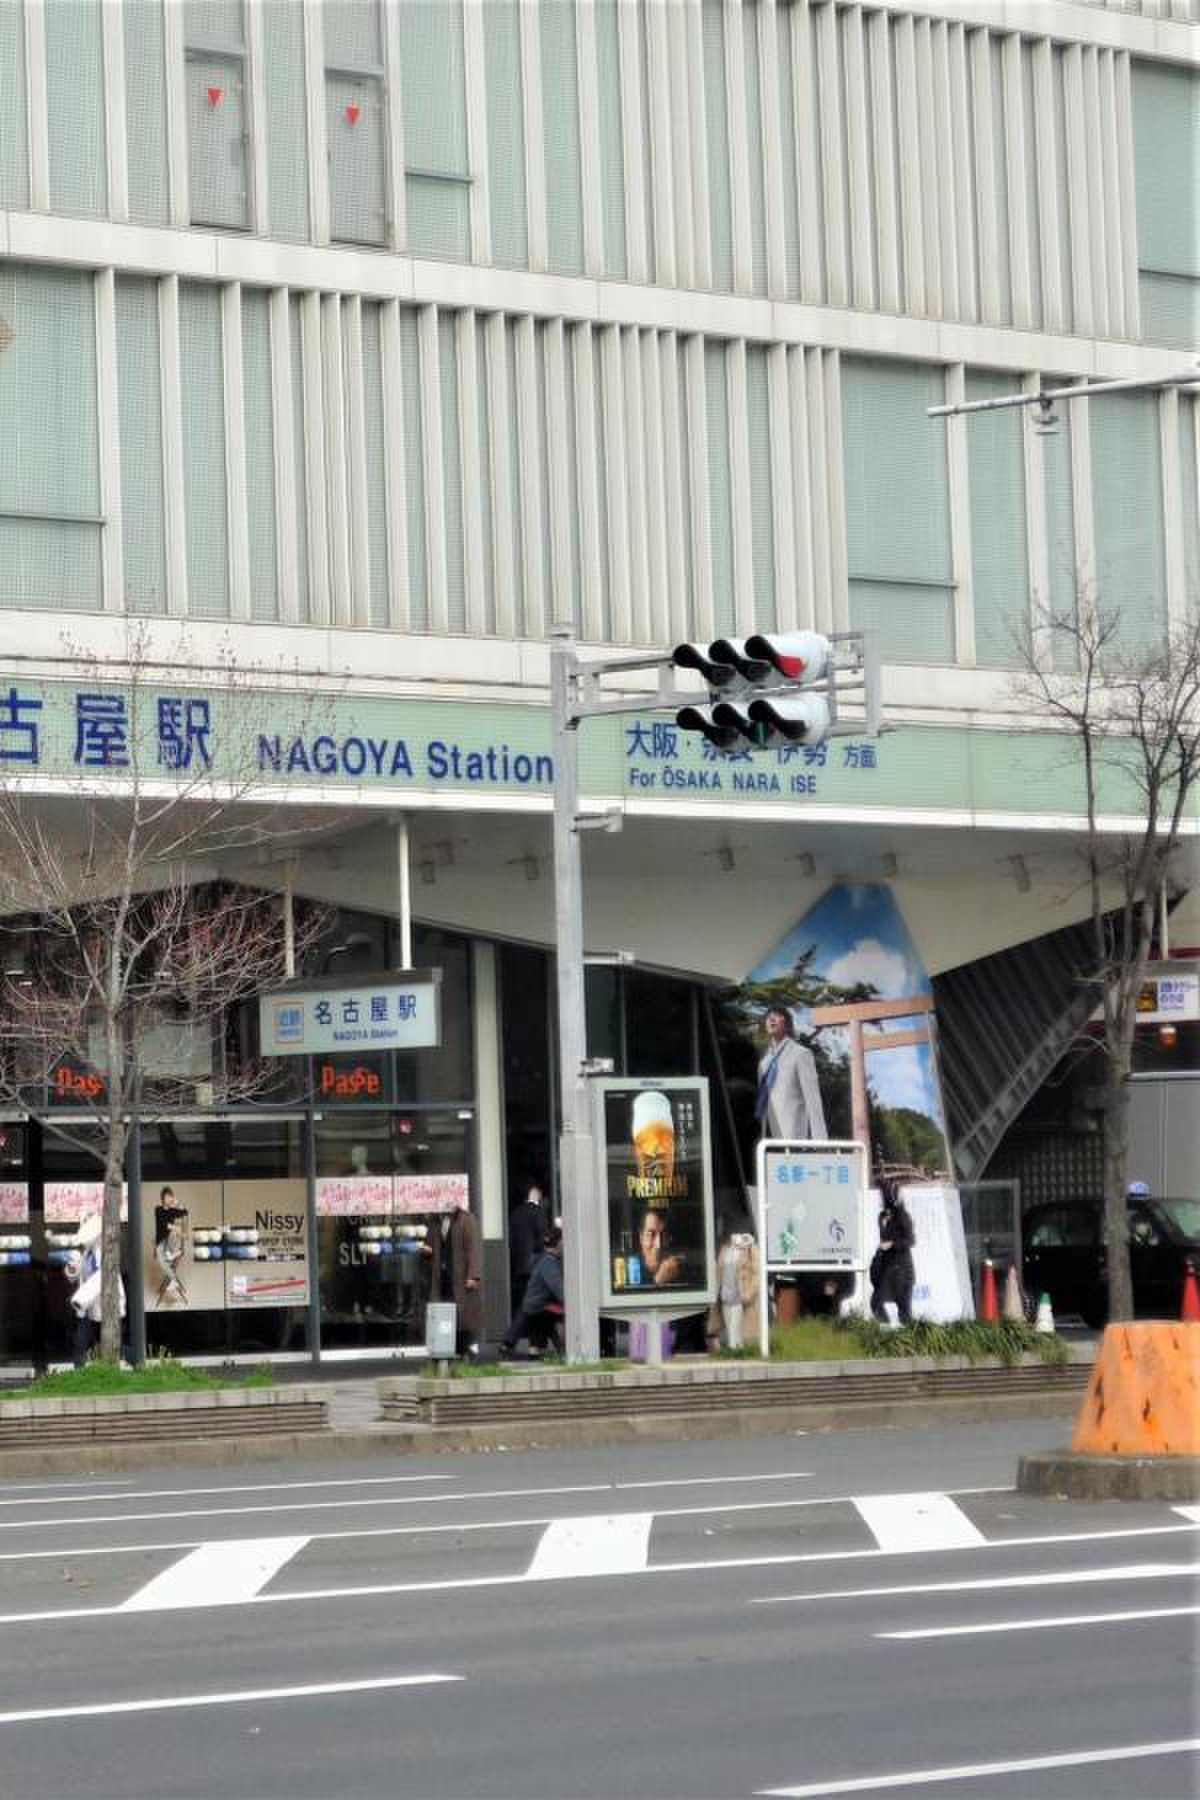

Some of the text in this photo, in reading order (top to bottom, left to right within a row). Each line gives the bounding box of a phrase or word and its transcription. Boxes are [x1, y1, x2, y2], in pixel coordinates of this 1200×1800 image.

[257, 733, 555, 784] NAGOYA Station
[630, 767, 656, 788] For
[733, 772, 781, 794] NARA
[791, 776, 816, 795] ISE
[314, 994, 417, 1025] 名古屋駅
[255, 1210, 304, 1233] Nissy
